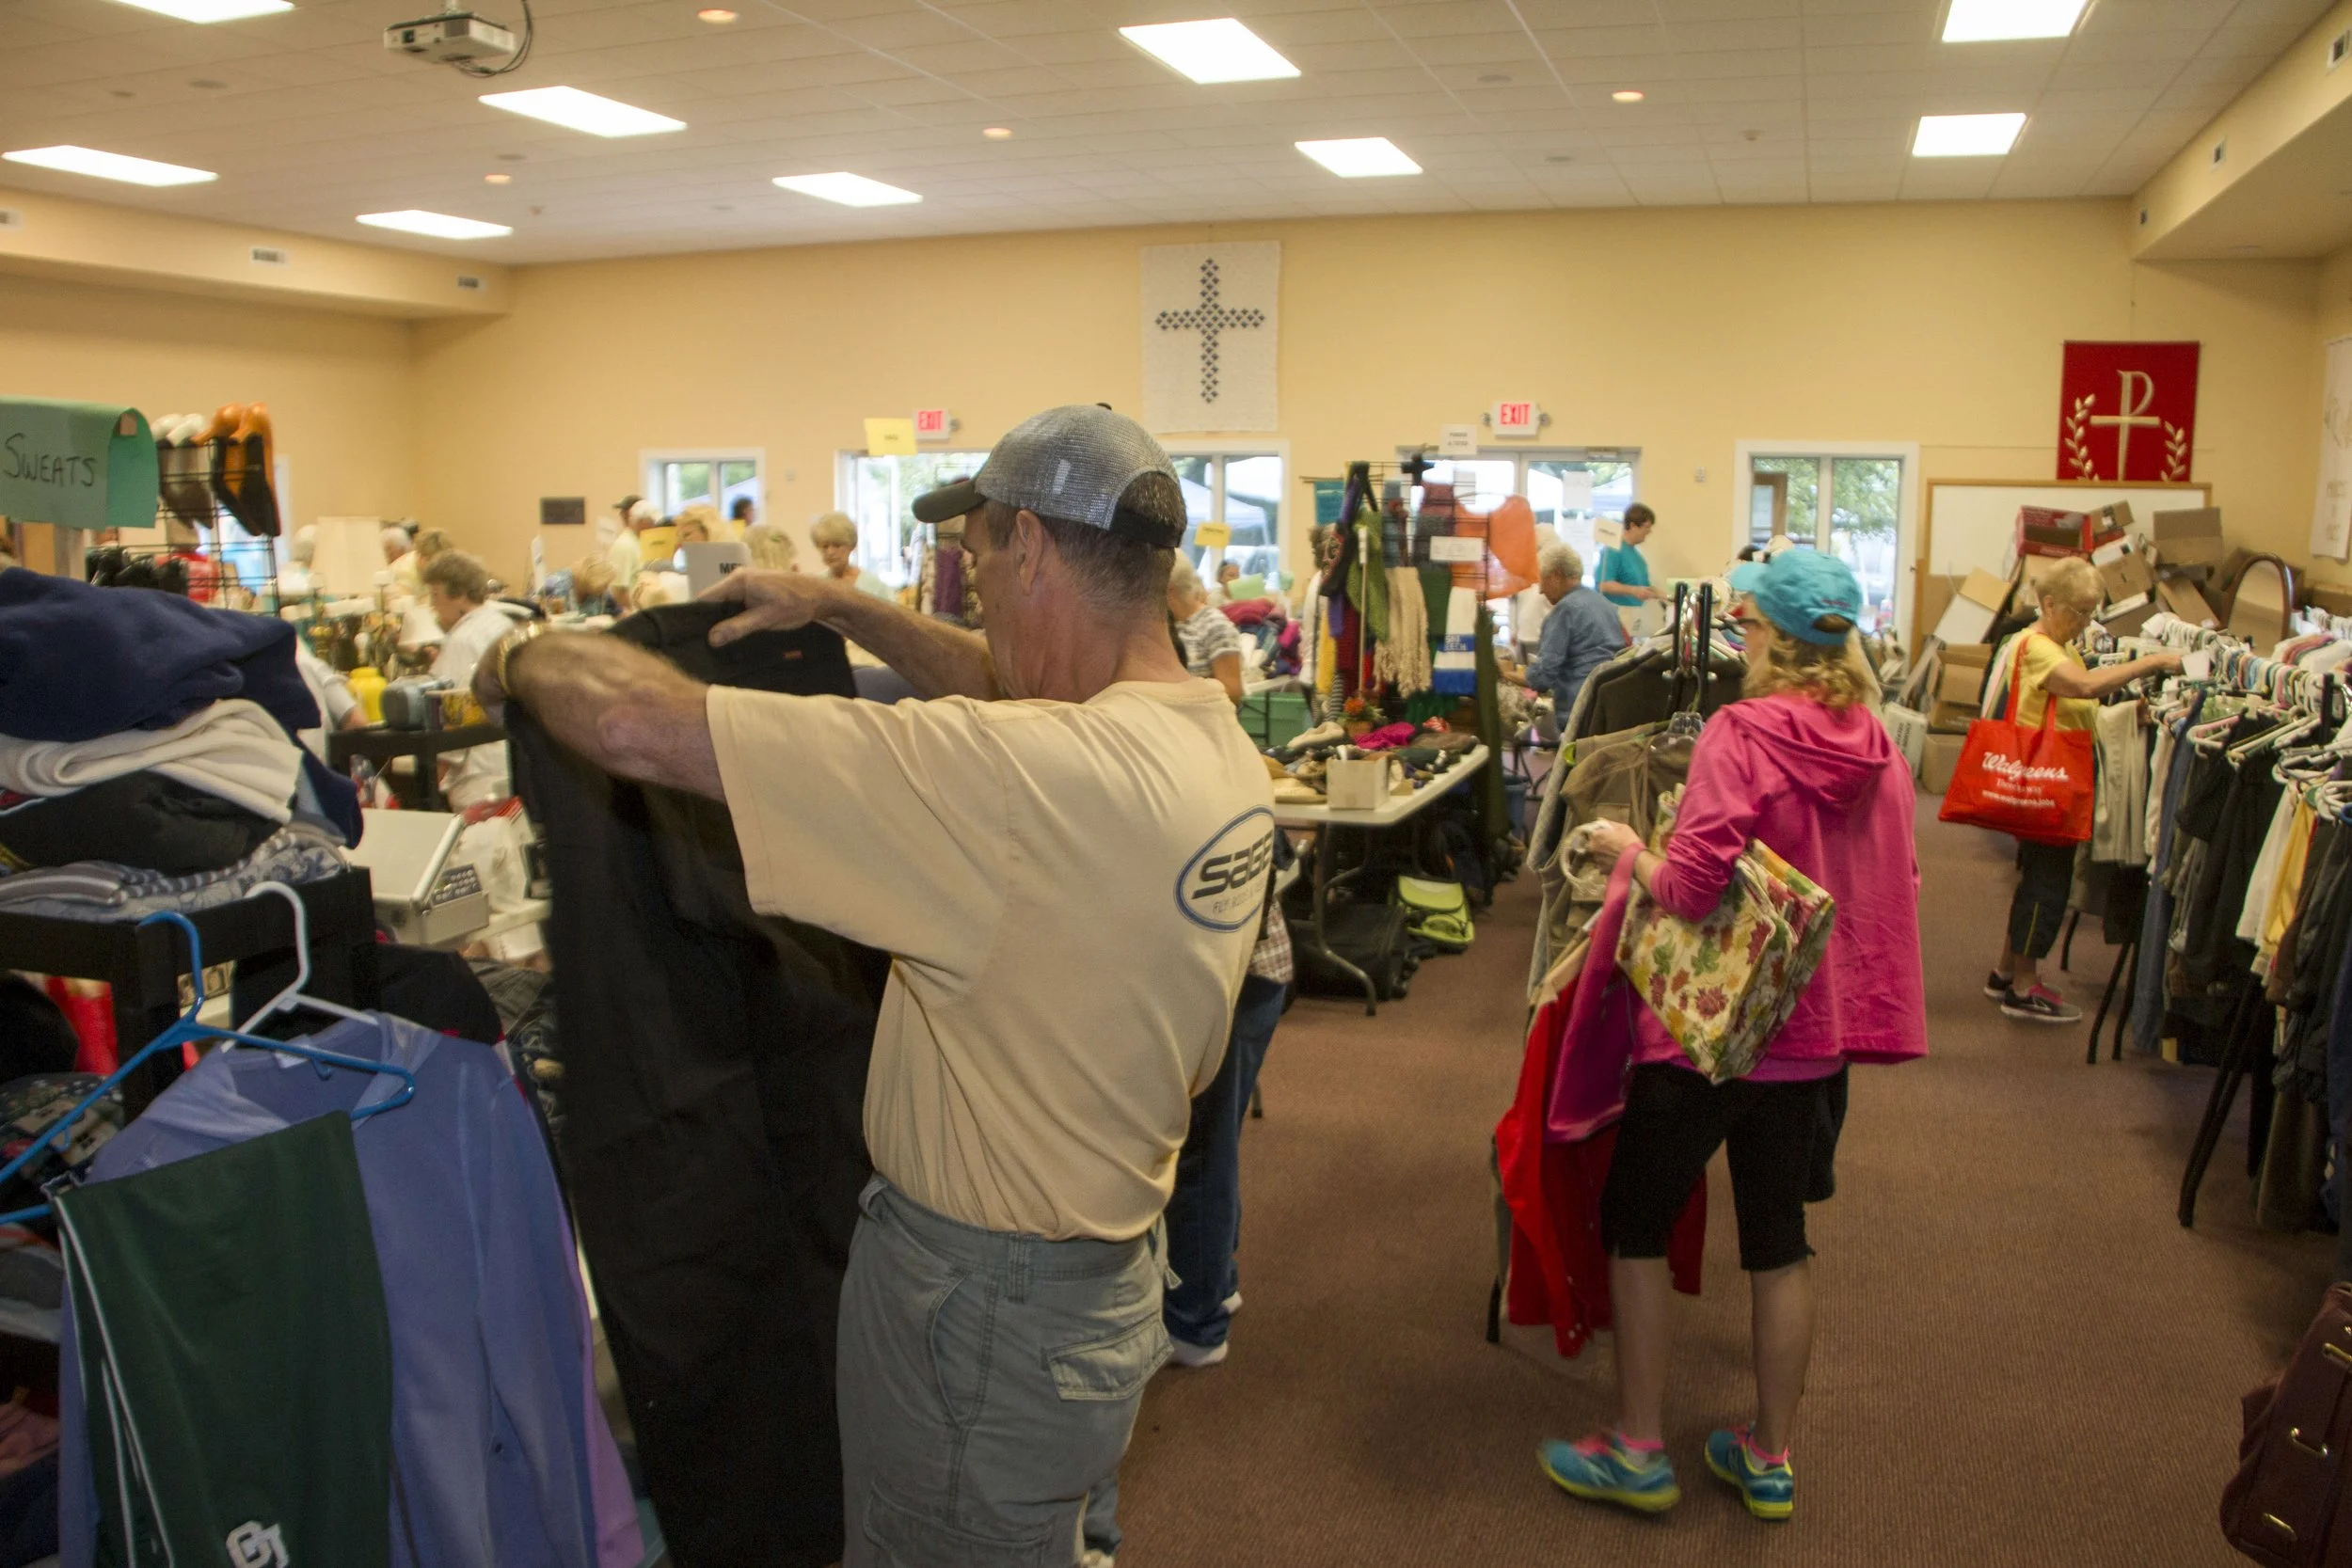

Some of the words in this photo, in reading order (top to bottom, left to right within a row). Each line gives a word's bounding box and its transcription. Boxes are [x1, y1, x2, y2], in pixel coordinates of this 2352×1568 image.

[917, 410, 944, 431] EXIT
[1500, 404, 1531, 425] EXIT
[4, 433, 98, 487] SWEATS
[719, 562, 741, 575] ME
[1981, 752, 2069, 783] Walgreens
